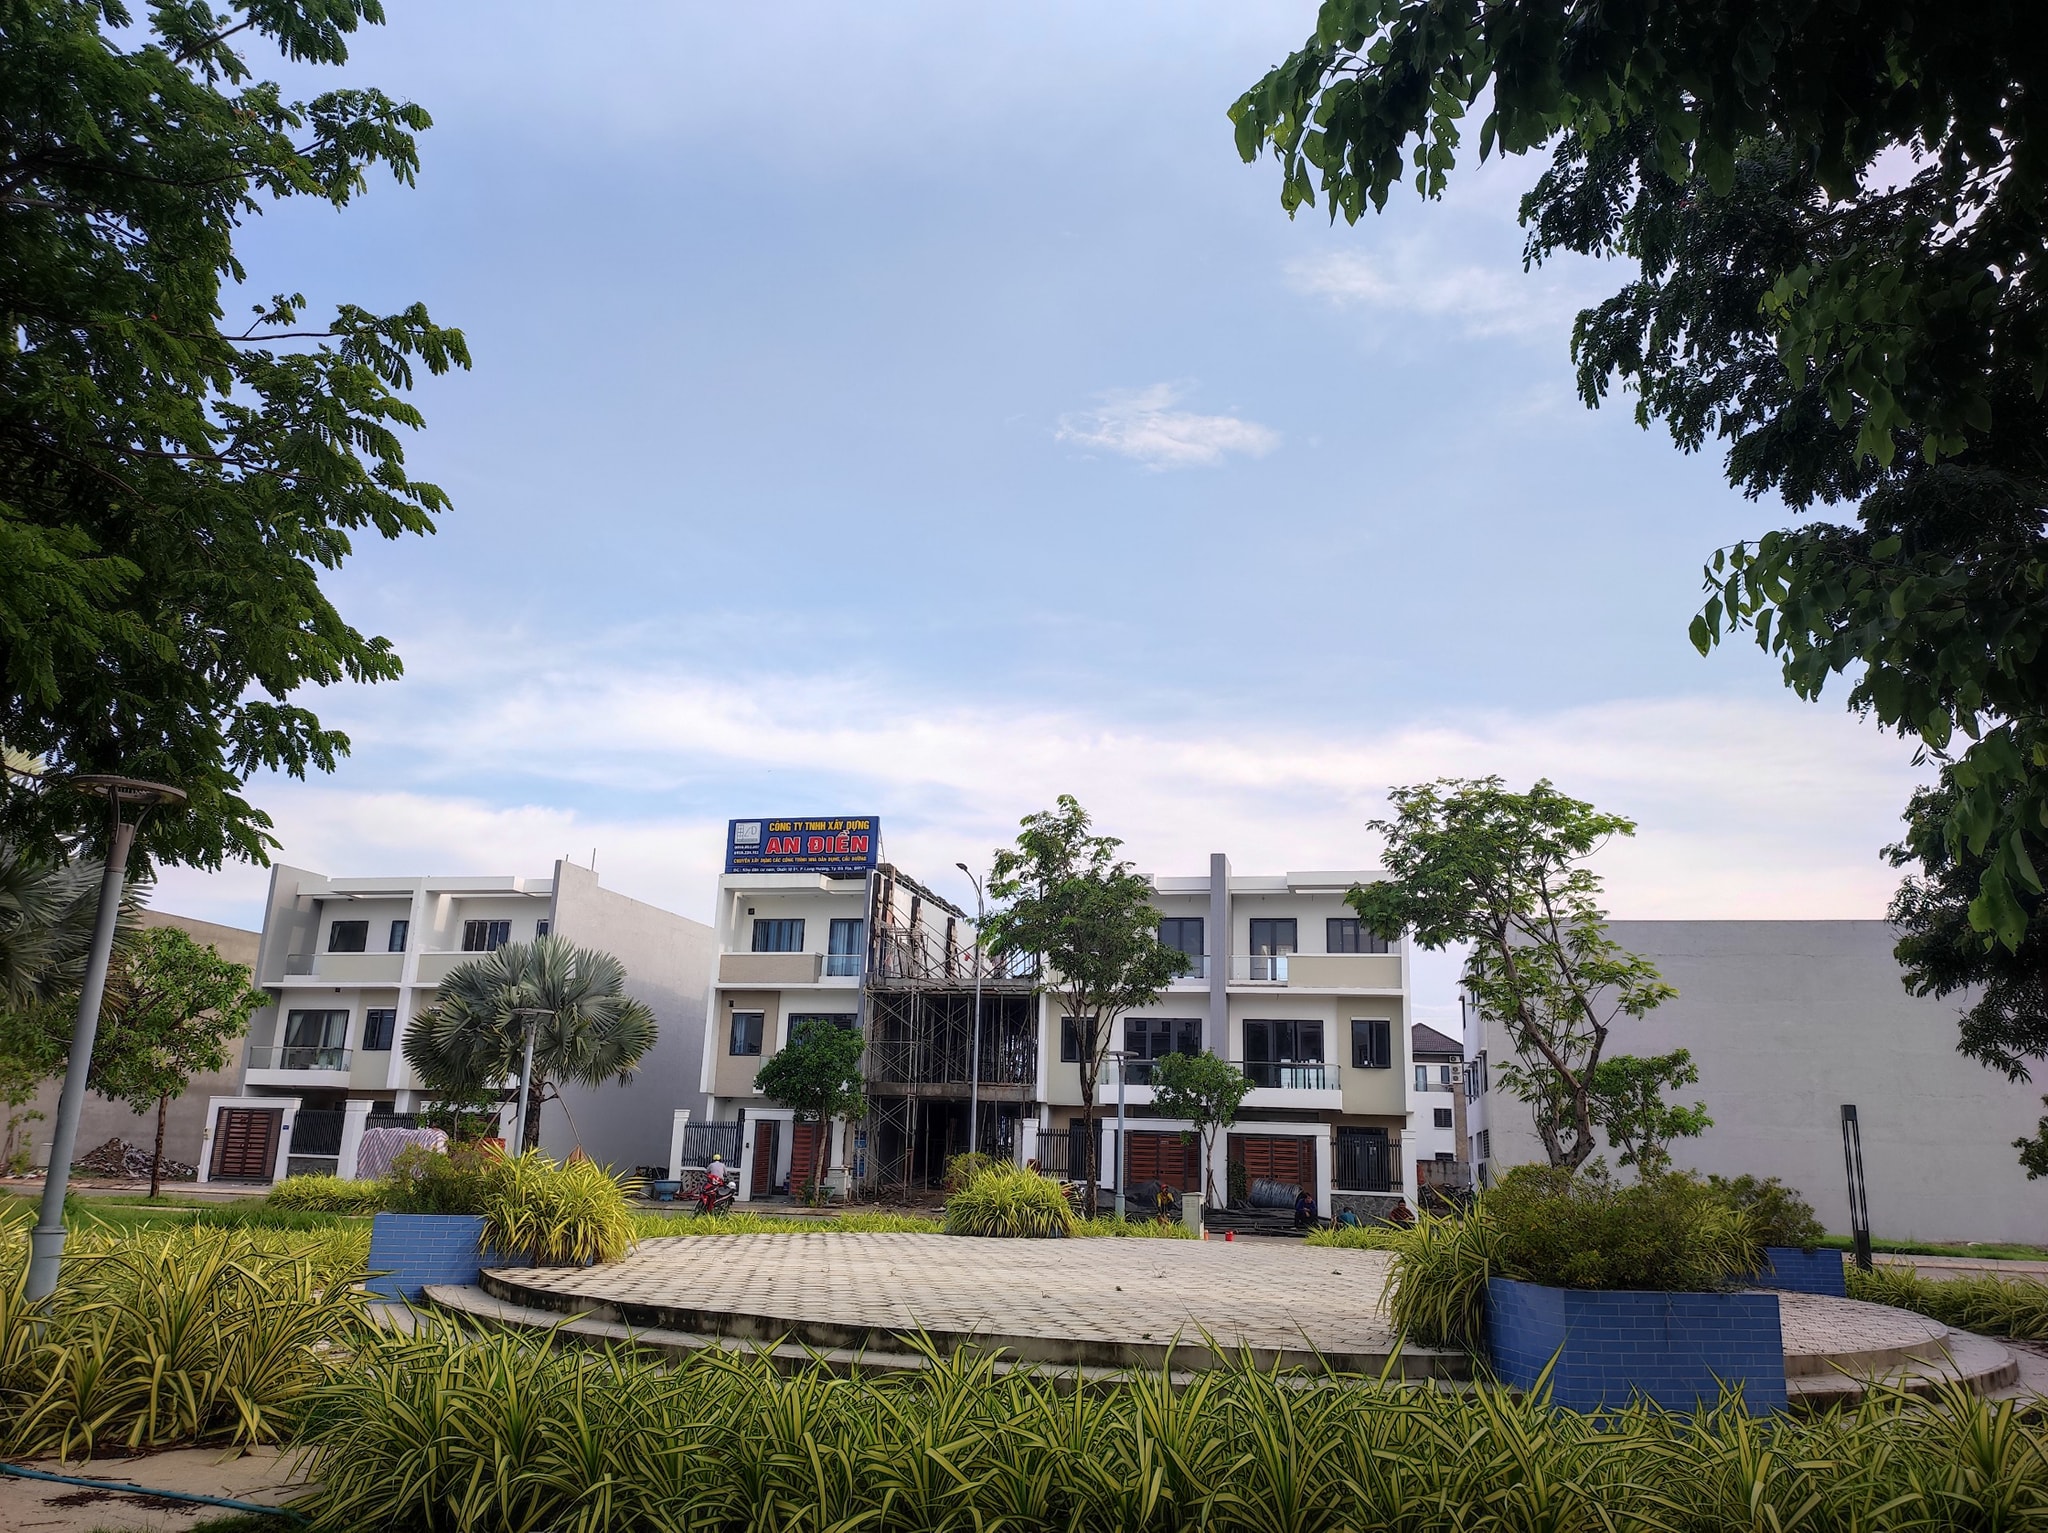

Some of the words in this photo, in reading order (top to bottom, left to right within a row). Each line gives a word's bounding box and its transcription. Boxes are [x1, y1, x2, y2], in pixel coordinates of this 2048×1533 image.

[769, 820, 791, 832] CÔNG
[794, 822, 803, 830] TY
[805, 822, 826, 830] TNHH
[828, 819, 844, 830] XÂY
[846, 820, 869, 831] DỰNG
[765, 836, 801, 854] AN
[808, 830, 869, 853] ĐIỂN
